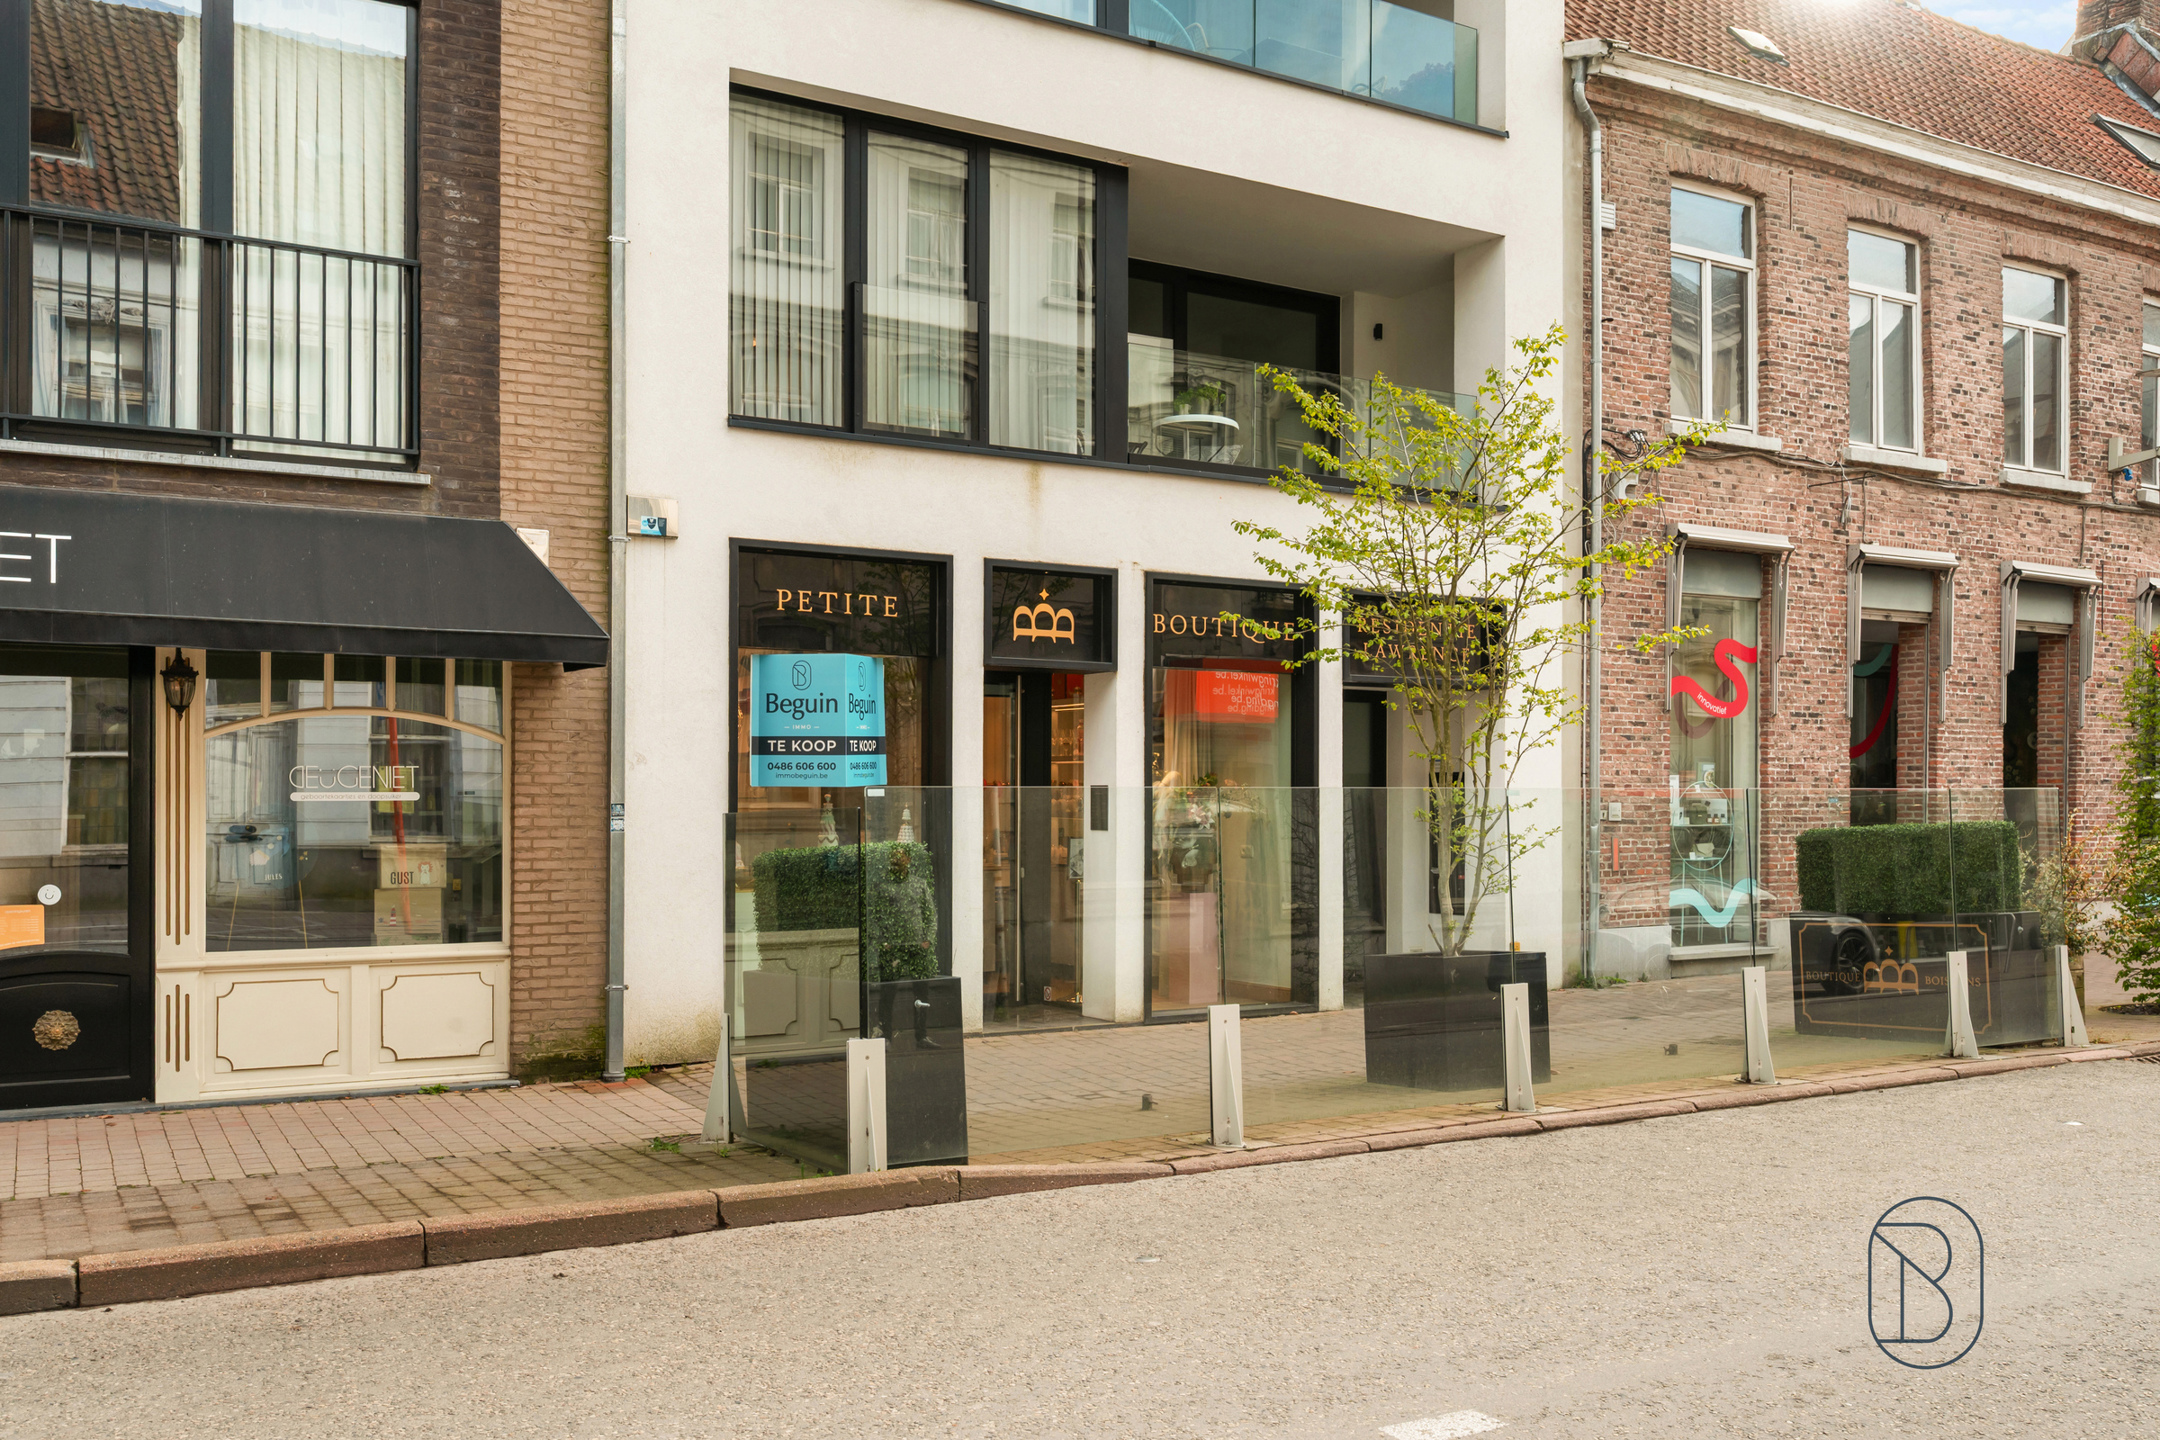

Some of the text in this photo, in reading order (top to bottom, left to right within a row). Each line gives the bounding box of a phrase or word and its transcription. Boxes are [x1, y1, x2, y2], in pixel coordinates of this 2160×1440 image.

[776, 588, 898, 617] PETITE
[1153, 613, 1295, 644] BOUTIQUE
[765, 692, 838, 720] Beguin
[848, 693, 877, 720] Beguin
[1696, 691, 1728, 715] innovatief
[767, 740, 837, 752] TE KOOP
[849, 740, 877, 752] TE KOOP
[767, 762, 837, 771] 0486 606 600
[775, 772, 828, 780] immobeguin.be
[390, 871, 414, 885] GUST
[1805, 970, 1861, 984] BOUTIQUE
